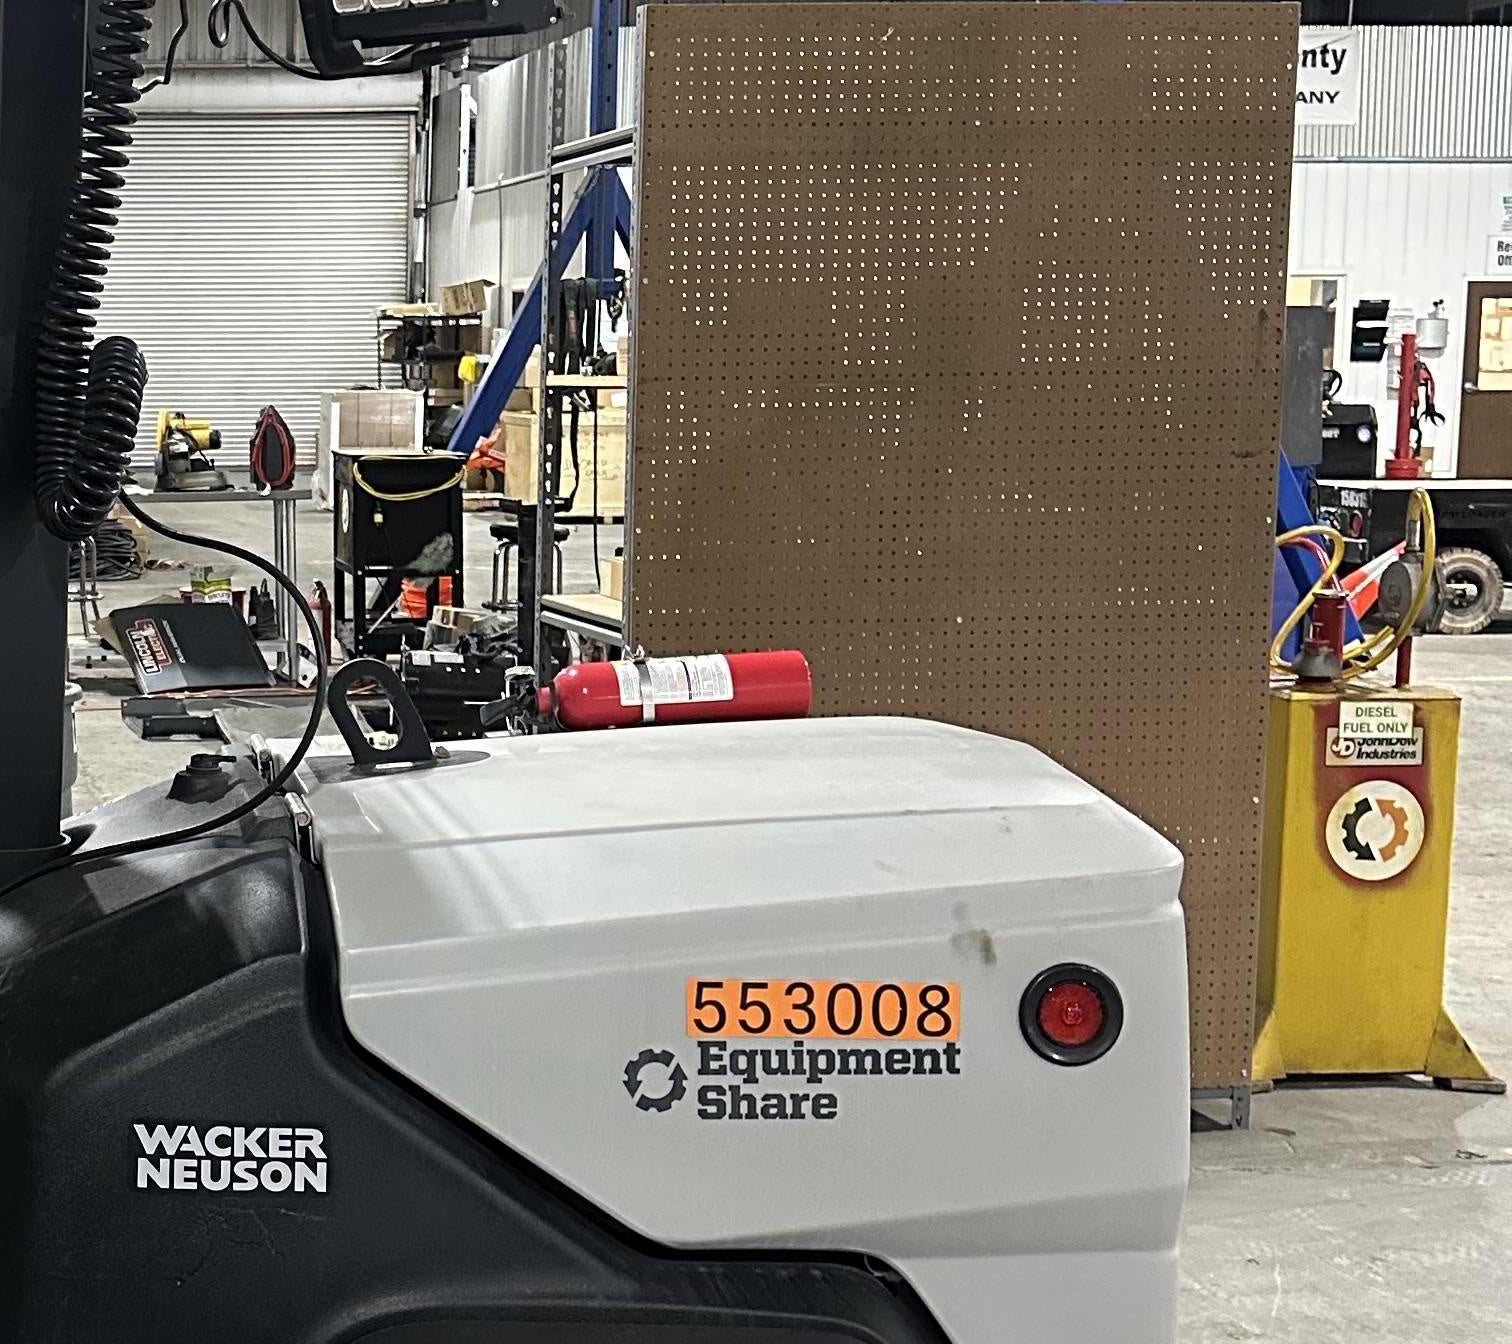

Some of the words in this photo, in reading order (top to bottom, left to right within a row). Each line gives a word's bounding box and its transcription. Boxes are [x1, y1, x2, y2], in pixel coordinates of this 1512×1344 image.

[1302, 43, 1346, 75] nty
[1296, 91, 1340, 104] ANY
[130, 629, 160, 674] LINCOLN
[142, 621, 167, 661] ELECTRIC
[1343, 722, 1374, 733] FUEL
[1376, 722, 1408, 733] ONLY
[1355, 707, 1398, 717] DIESEL
[1356, 747, 1417, 760] Industries
[693, 981, 953, 1037] 553008
[696, 1041, 961, 1083] Equipment
[696, 1084, 838, 1120] Share
[133, 1123, 328, 1159] WACKER
[136, 1157, 328, 1193] NEUSON
